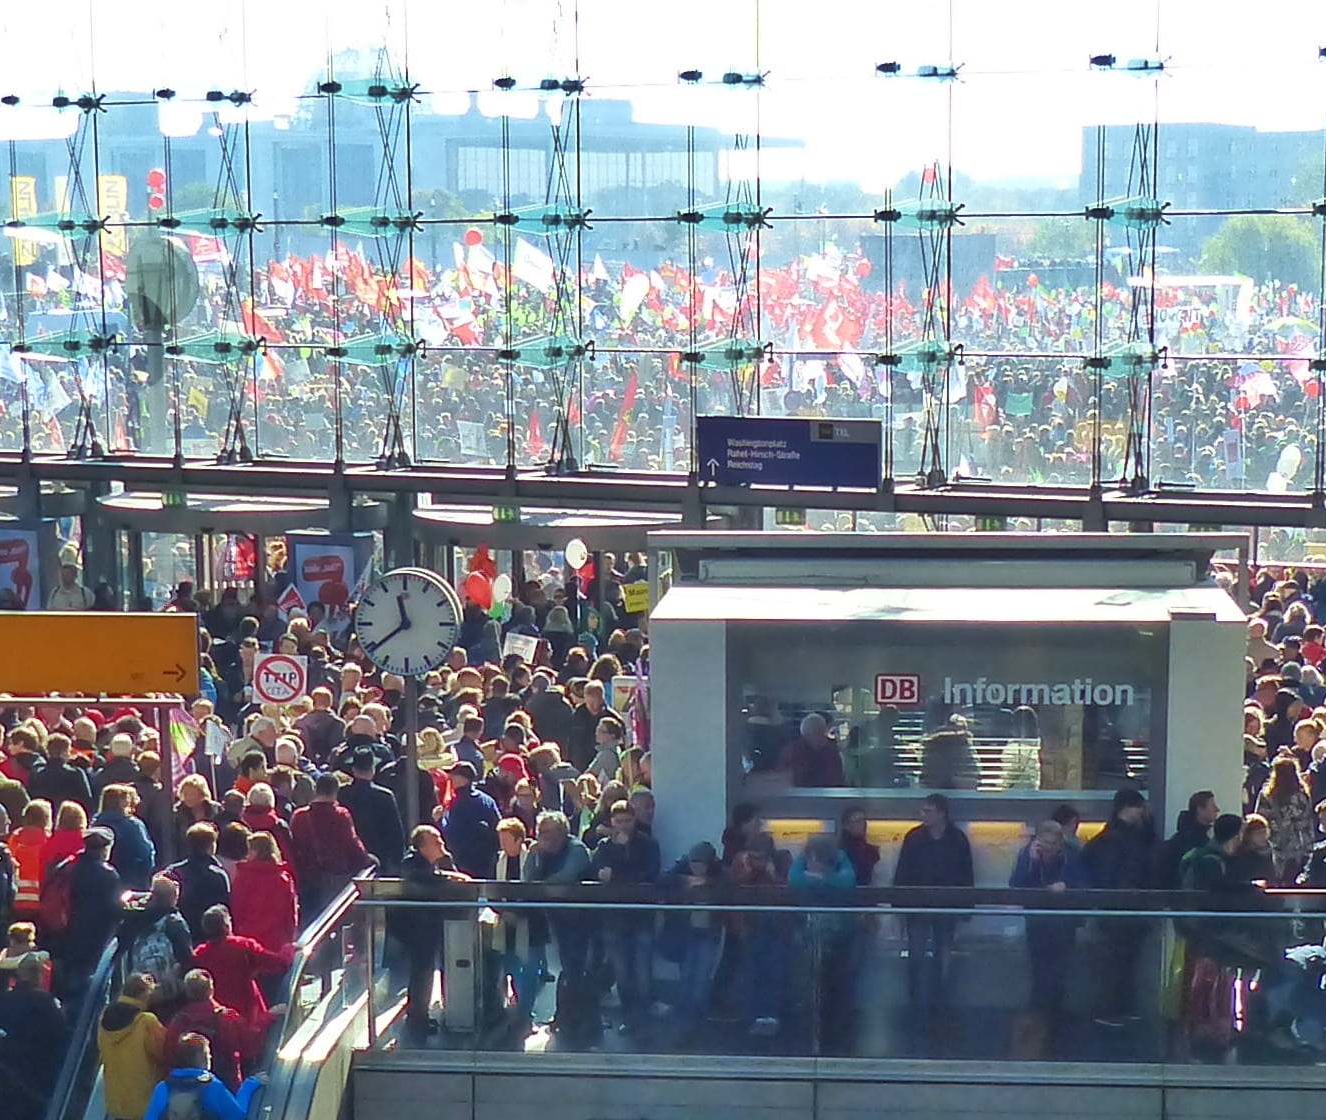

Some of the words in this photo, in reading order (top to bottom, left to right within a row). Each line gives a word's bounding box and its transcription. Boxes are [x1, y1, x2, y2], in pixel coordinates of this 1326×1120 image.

[263, 671, 298, 684] TTIP
[878, 677, 918, 702] DB
[943, 676, 1135, 706] Information
